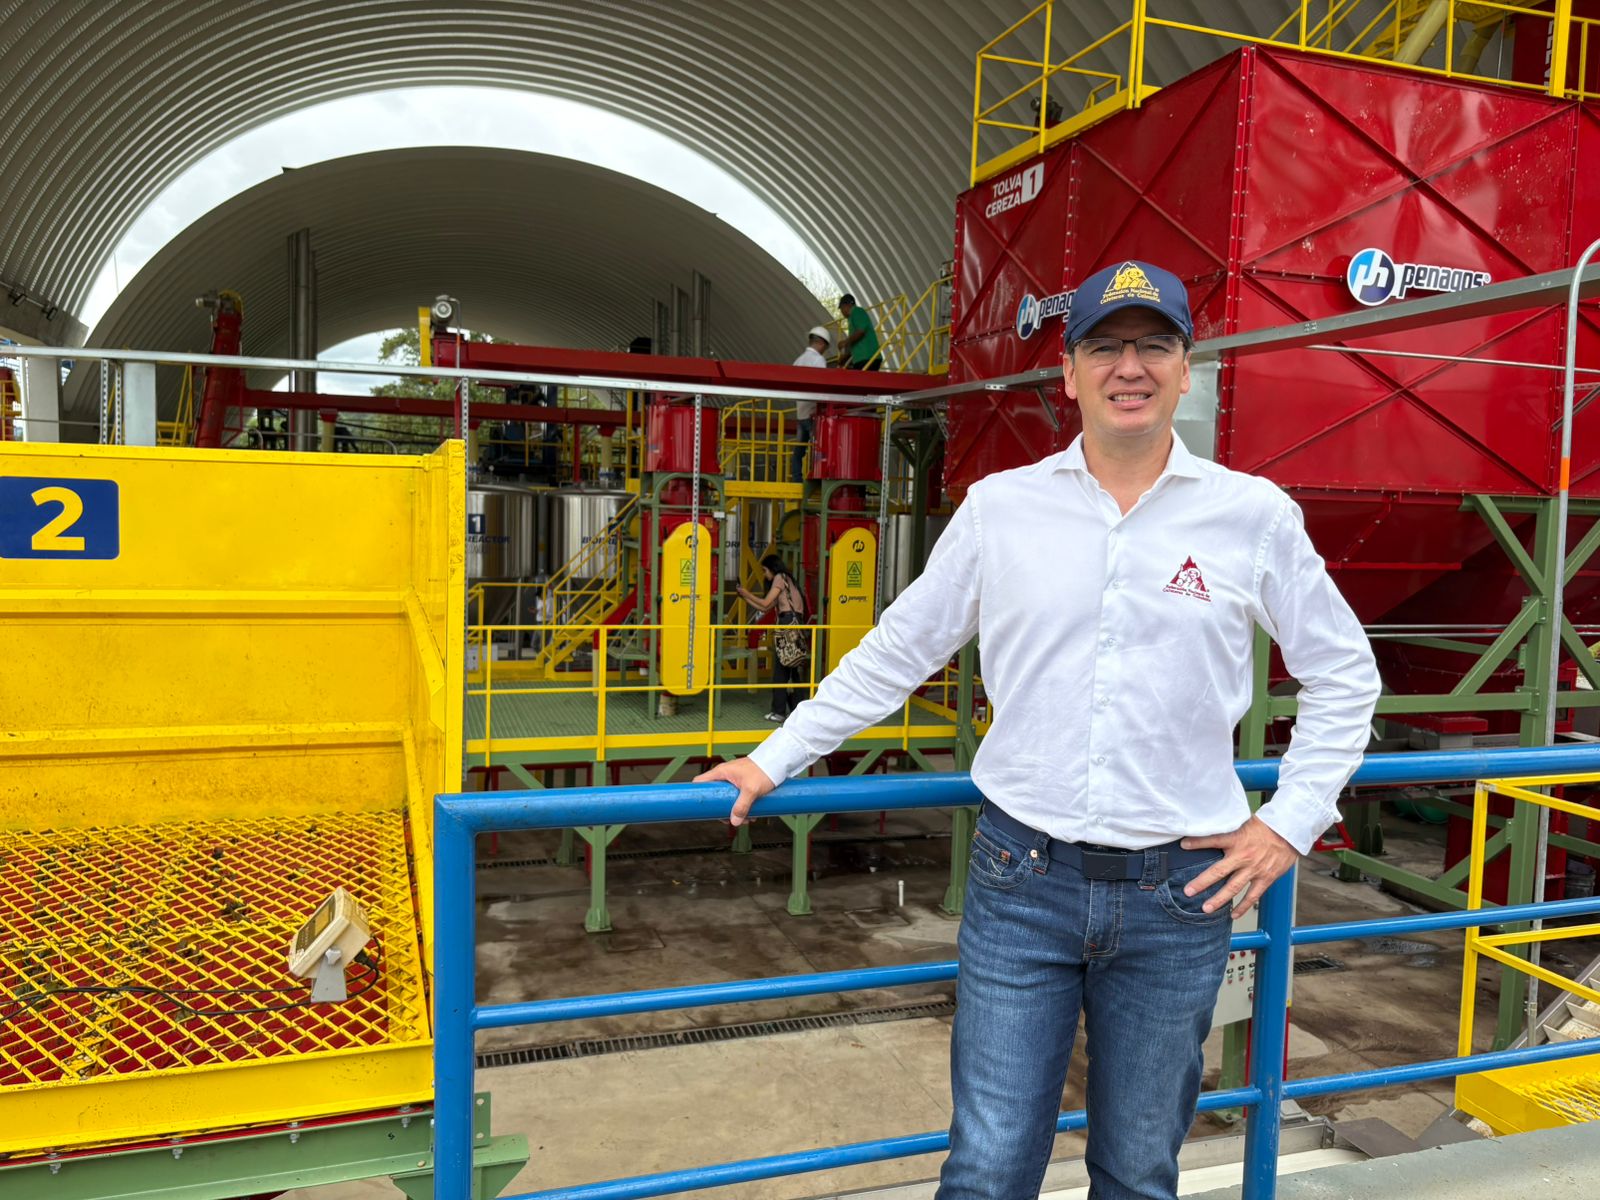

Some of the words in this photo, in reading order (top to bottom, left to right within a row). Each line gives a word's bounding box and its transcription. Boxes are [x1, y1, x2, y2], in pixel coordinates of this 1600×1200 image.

[993, 173, 1022, 198] TOLVA
[985, 191, 1020, 219] CEREZA
[1036, 292, 1074, 329] penag
[31, 486, 86, 551] 2
[471, 515, 481, 533] 1
